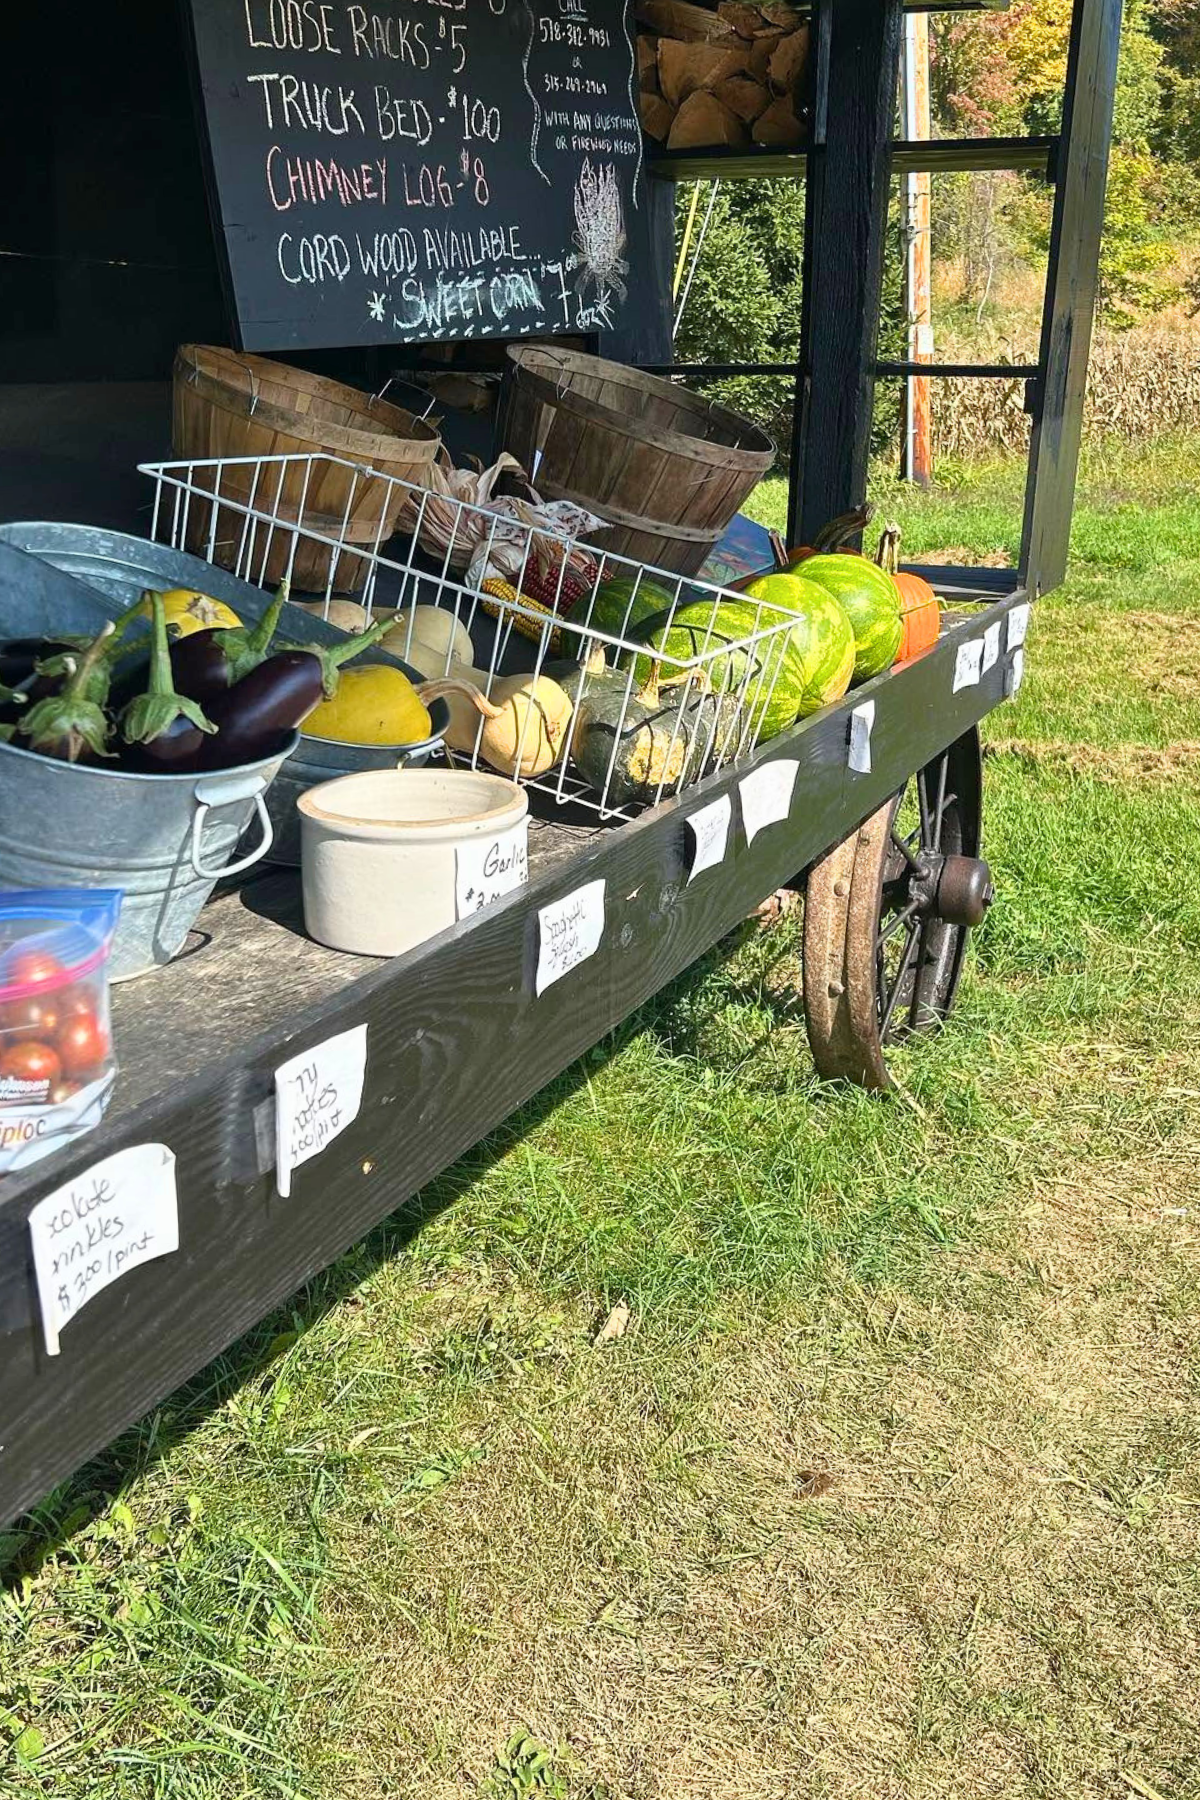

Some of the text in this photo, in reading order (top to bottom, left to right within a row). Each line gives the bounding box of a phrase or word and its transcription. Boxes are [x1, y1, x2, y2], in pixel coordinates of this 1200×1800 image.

[245, 0, 342, 54] LOOSE
[247, 73, 366, 135] TRUCK
[543, 110, 570, 127] WITH
[573, 110, 592, 132] ANY
[555, 135, 569, 150] OR
[266, 145, 389, 211] CHIMNEY
[278, 232, 351, 285] CORD
[355, 227, 420, 279] WOOD
[393, 275, 486, 331] SWEET
[488, 268, 546, 321] CORN
[483, 841, 526, 878] Garlic
